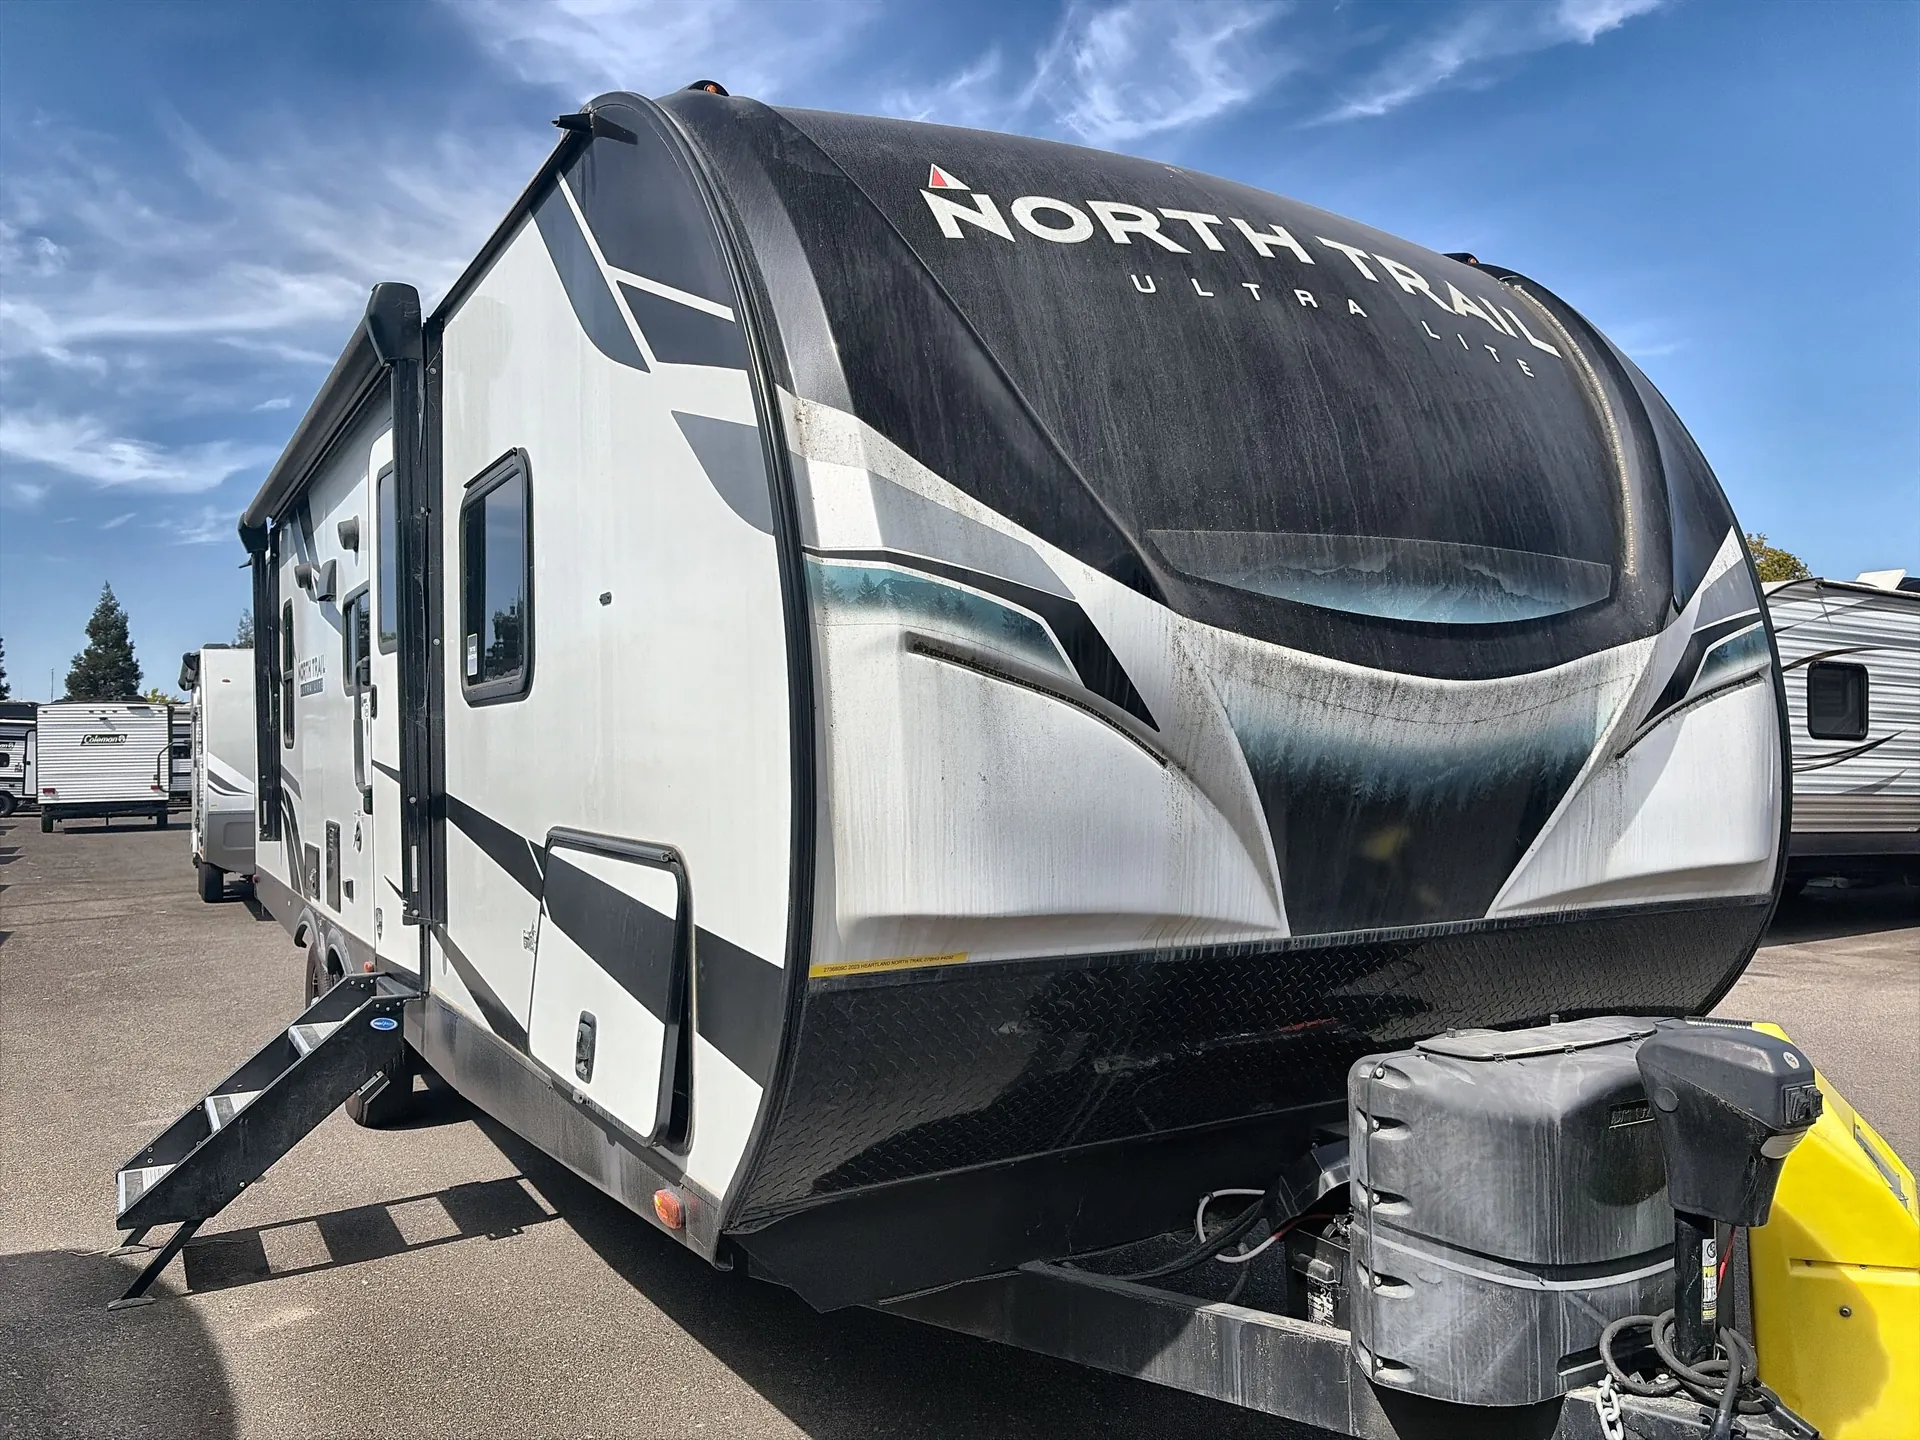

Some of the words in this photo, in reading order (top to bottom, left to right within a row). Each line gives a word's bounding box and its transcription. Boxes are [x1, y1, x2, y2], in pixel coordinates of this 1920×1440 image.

[919, 187, 1316, 266] NORTH
[1315, 235, 1563, 360] TRAIL
[1130, 273, 1368, 319] ULTRA
[1420, 320, 1536, 379] LITE
[84, 734, 118, 743] Coleman
[860, 961, 891, 969] HEARTLAND
